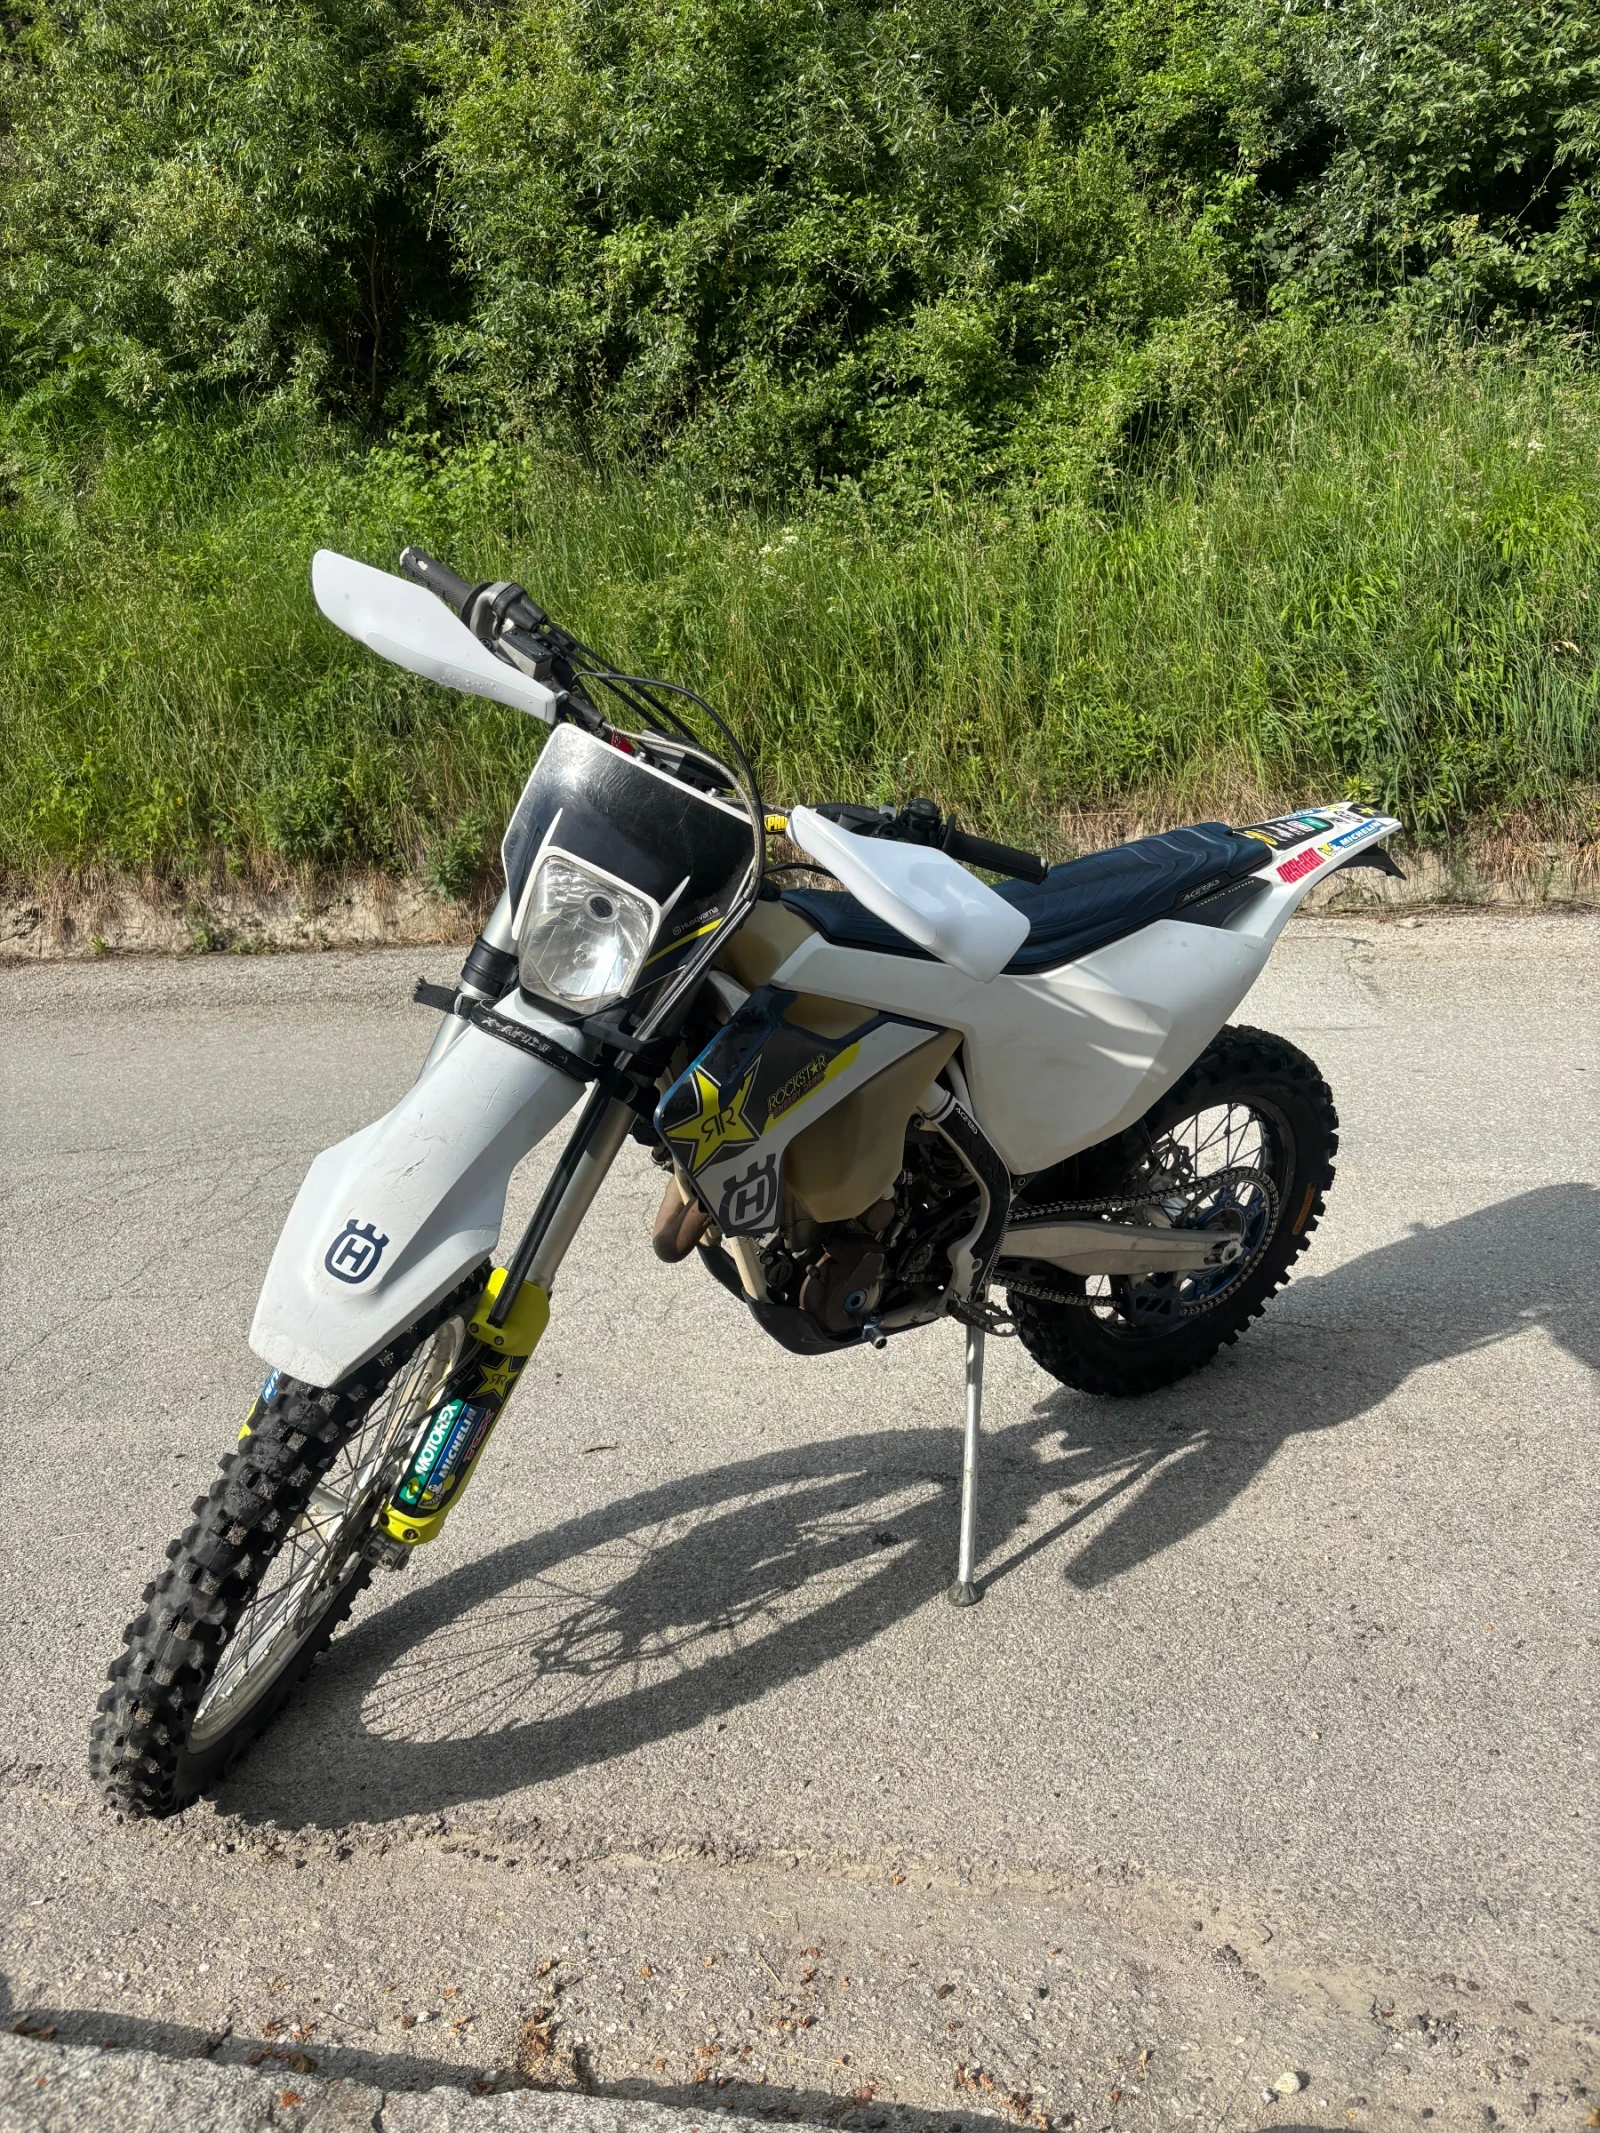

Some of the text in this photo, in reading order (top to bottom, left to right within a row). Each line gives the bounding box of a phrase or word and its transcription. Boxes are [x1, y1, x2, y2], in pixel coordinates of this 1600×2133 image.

[1339, 821, 1382, 846] MICHELIN
[680, 906, 719, 930] Husqvarna
[955, 1107, 978, 1135] ACERBIS
[414, 1404, 458, 1477] MOTOREX
[438, 1407, 478, 1479] MICHELIN
